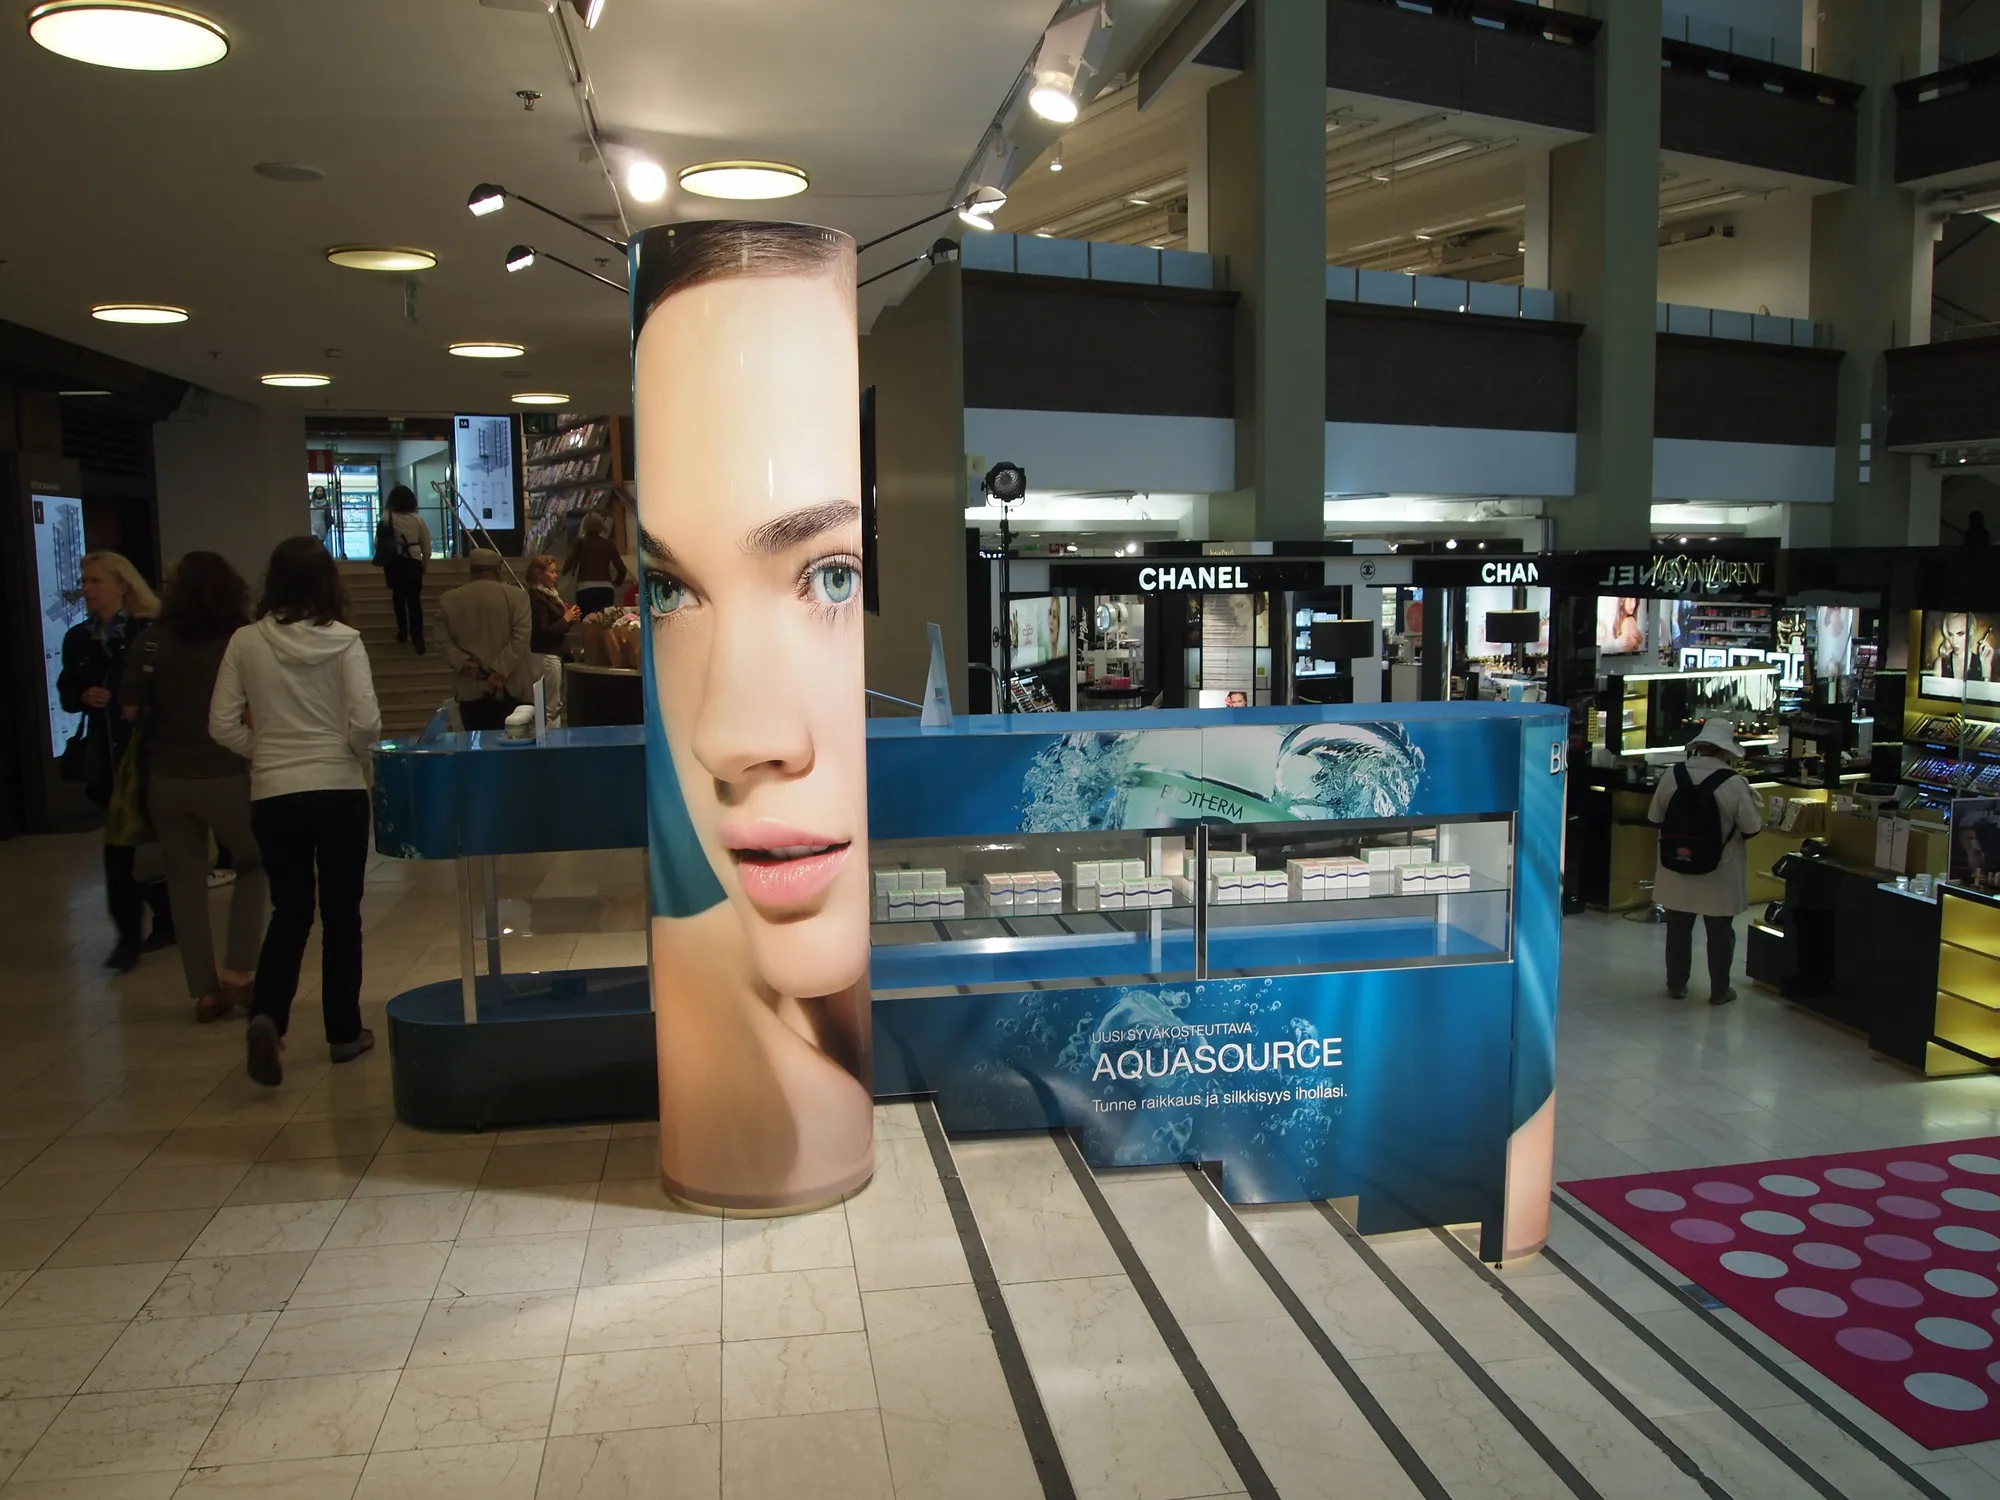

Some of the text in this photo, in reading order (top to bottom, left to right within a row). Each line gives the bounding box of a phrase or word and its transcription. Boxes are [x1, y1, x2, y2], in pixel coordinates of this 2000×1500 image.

[1138, 566, 1249, 591] CHANEL
[1092, 1022, 1252, 1044] UUSI SYVÄKOSTEUTTAVA
[1092, 1037, 1343, 1082] AQUASOURCE
[1092, 1084, 1348, 1113] Tunne raikkaus ja silkkisyys ihollasi.
